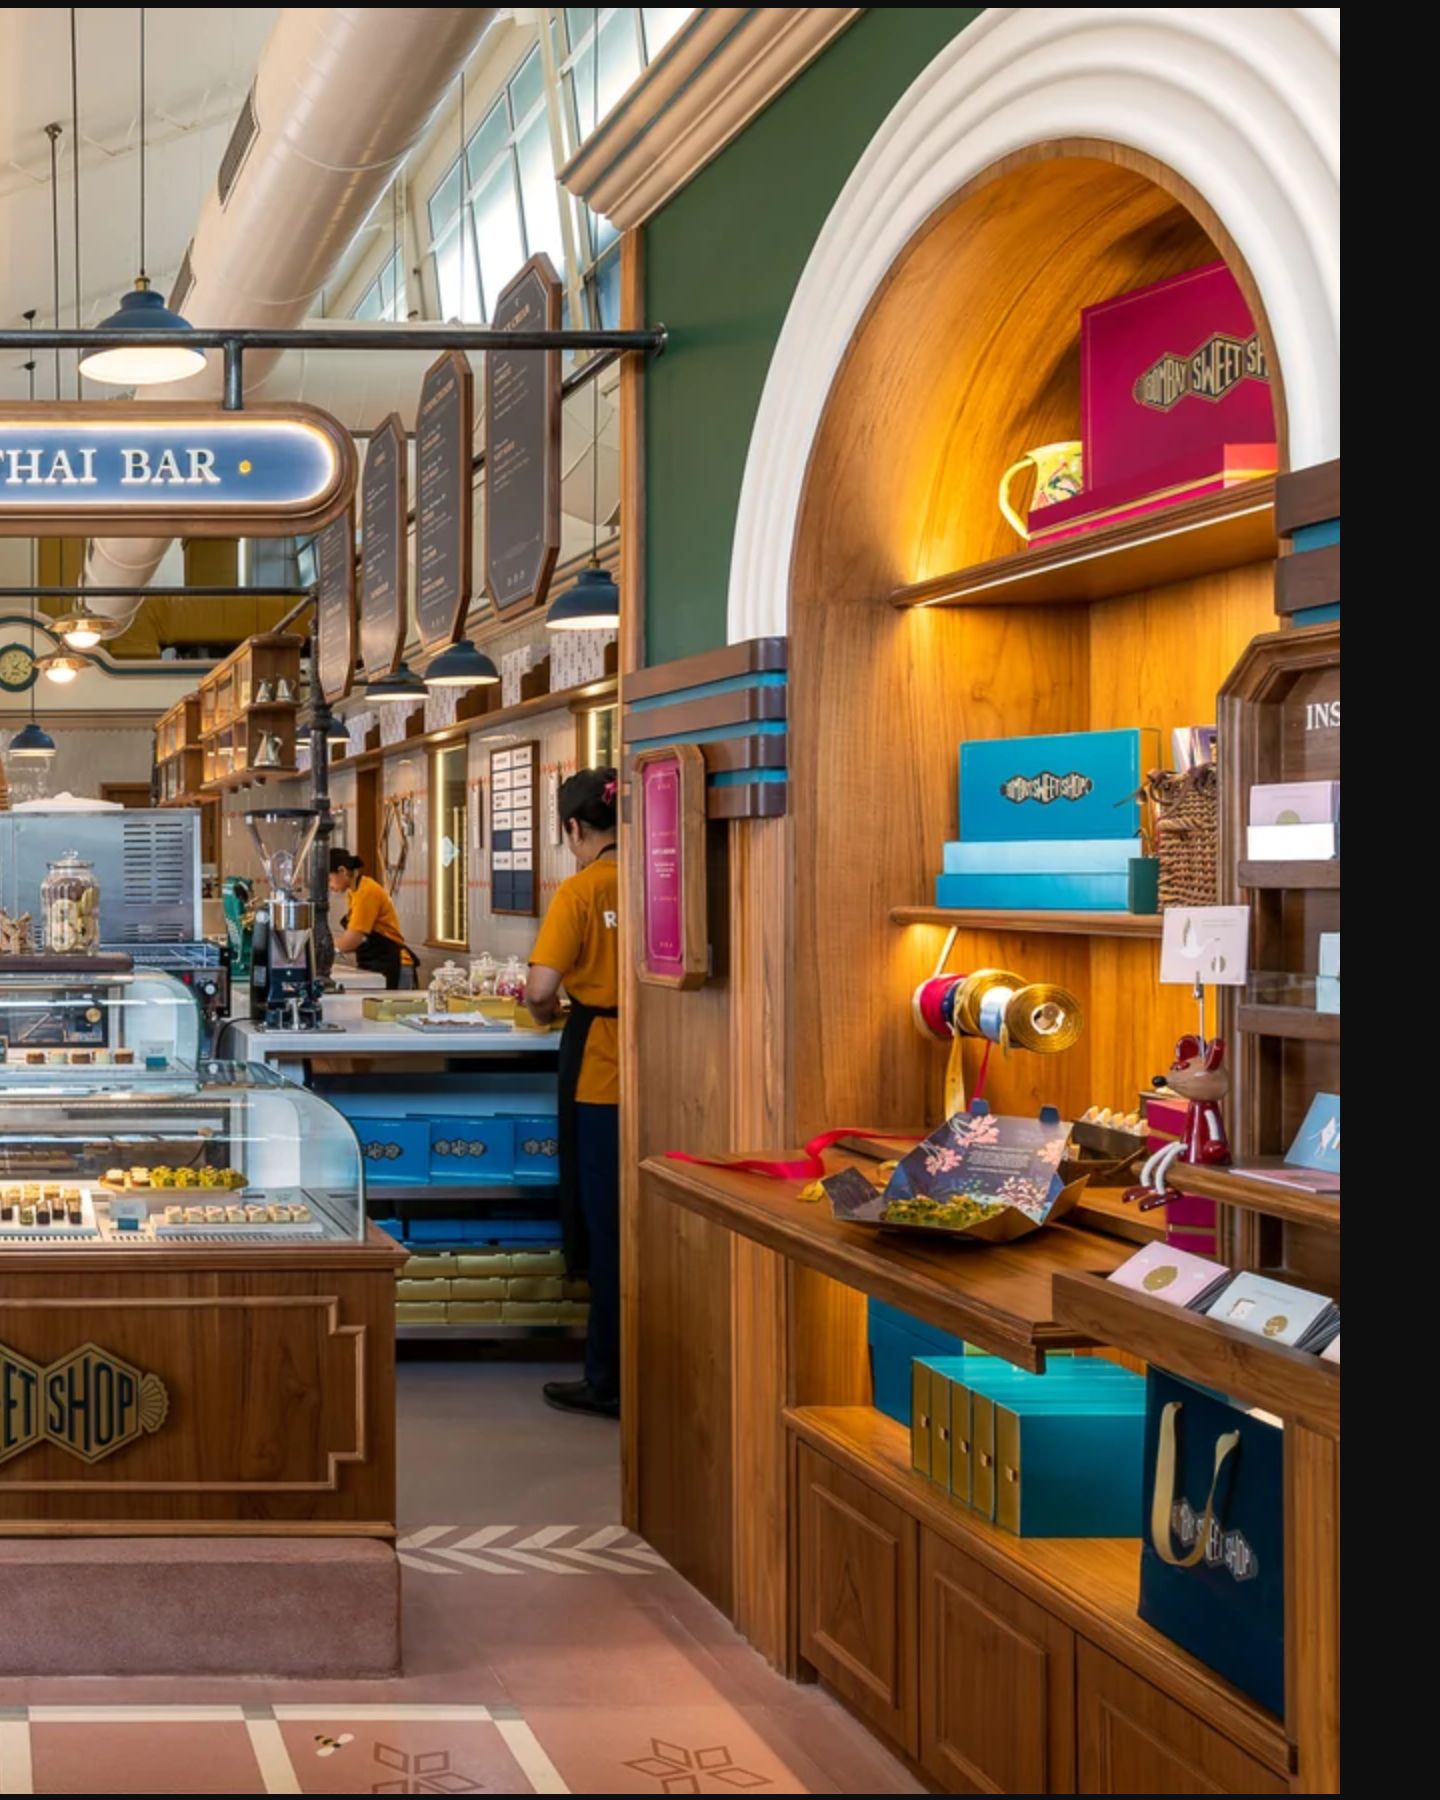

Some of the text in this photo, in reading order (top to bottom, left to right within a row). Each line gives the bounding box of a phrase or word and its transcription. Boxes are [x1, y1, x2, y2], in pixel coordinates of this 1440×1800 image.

[1193, 340, 1241, 394] SWEET
[121, 449, 221, 484] BAR
[1306, 701, 1340, 731] INS
[49, 1357, 133, 1453] SHOP
